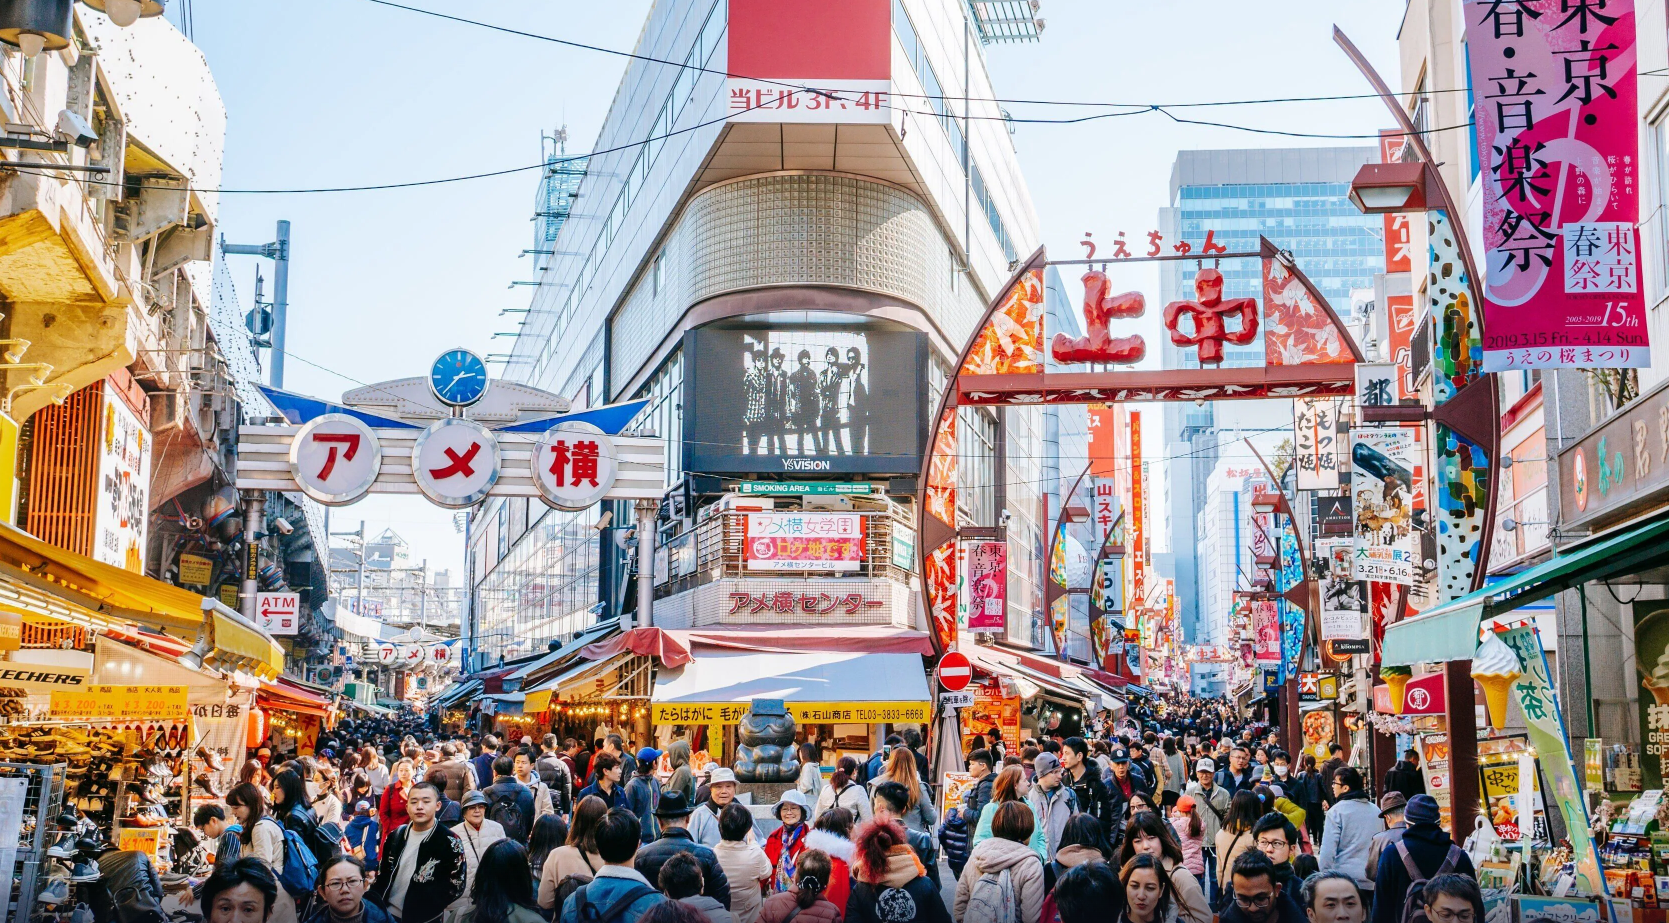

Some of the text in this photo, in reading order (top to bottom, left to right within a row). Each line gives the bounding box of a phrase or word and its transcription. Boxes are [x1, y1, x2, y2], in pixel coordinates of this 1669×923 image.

[730, 88, 799, 109] 当ビル
[1080, 229, 1228, 260] うえちゅん
[1567, 226, 1601, 290] 春祭
[1602, 225, 1634, 290] 東京
[1052, 268, 1259, 365] 上中
[1486, 332, 1547, 348] 2019.3.15
[1583, 331, 1611, 344] 4.14
[1616, 331, 1647, 345] Sun.
[313, 432, 600, 488] アメ横
[757, 516, 853, 534] アメ横女学園
[778, 541, 853, 557] ロケ地です
[1358, 565, 1378, 573] 3.21
[1389, 567, 1408, 577] 6.16
[261, 597, 295, 608] ATM
[729, 591, 884, 614] アメ横センター
[382, 648, 446, 660] アメ横
[660, 707, 713, 721] たらばがに
